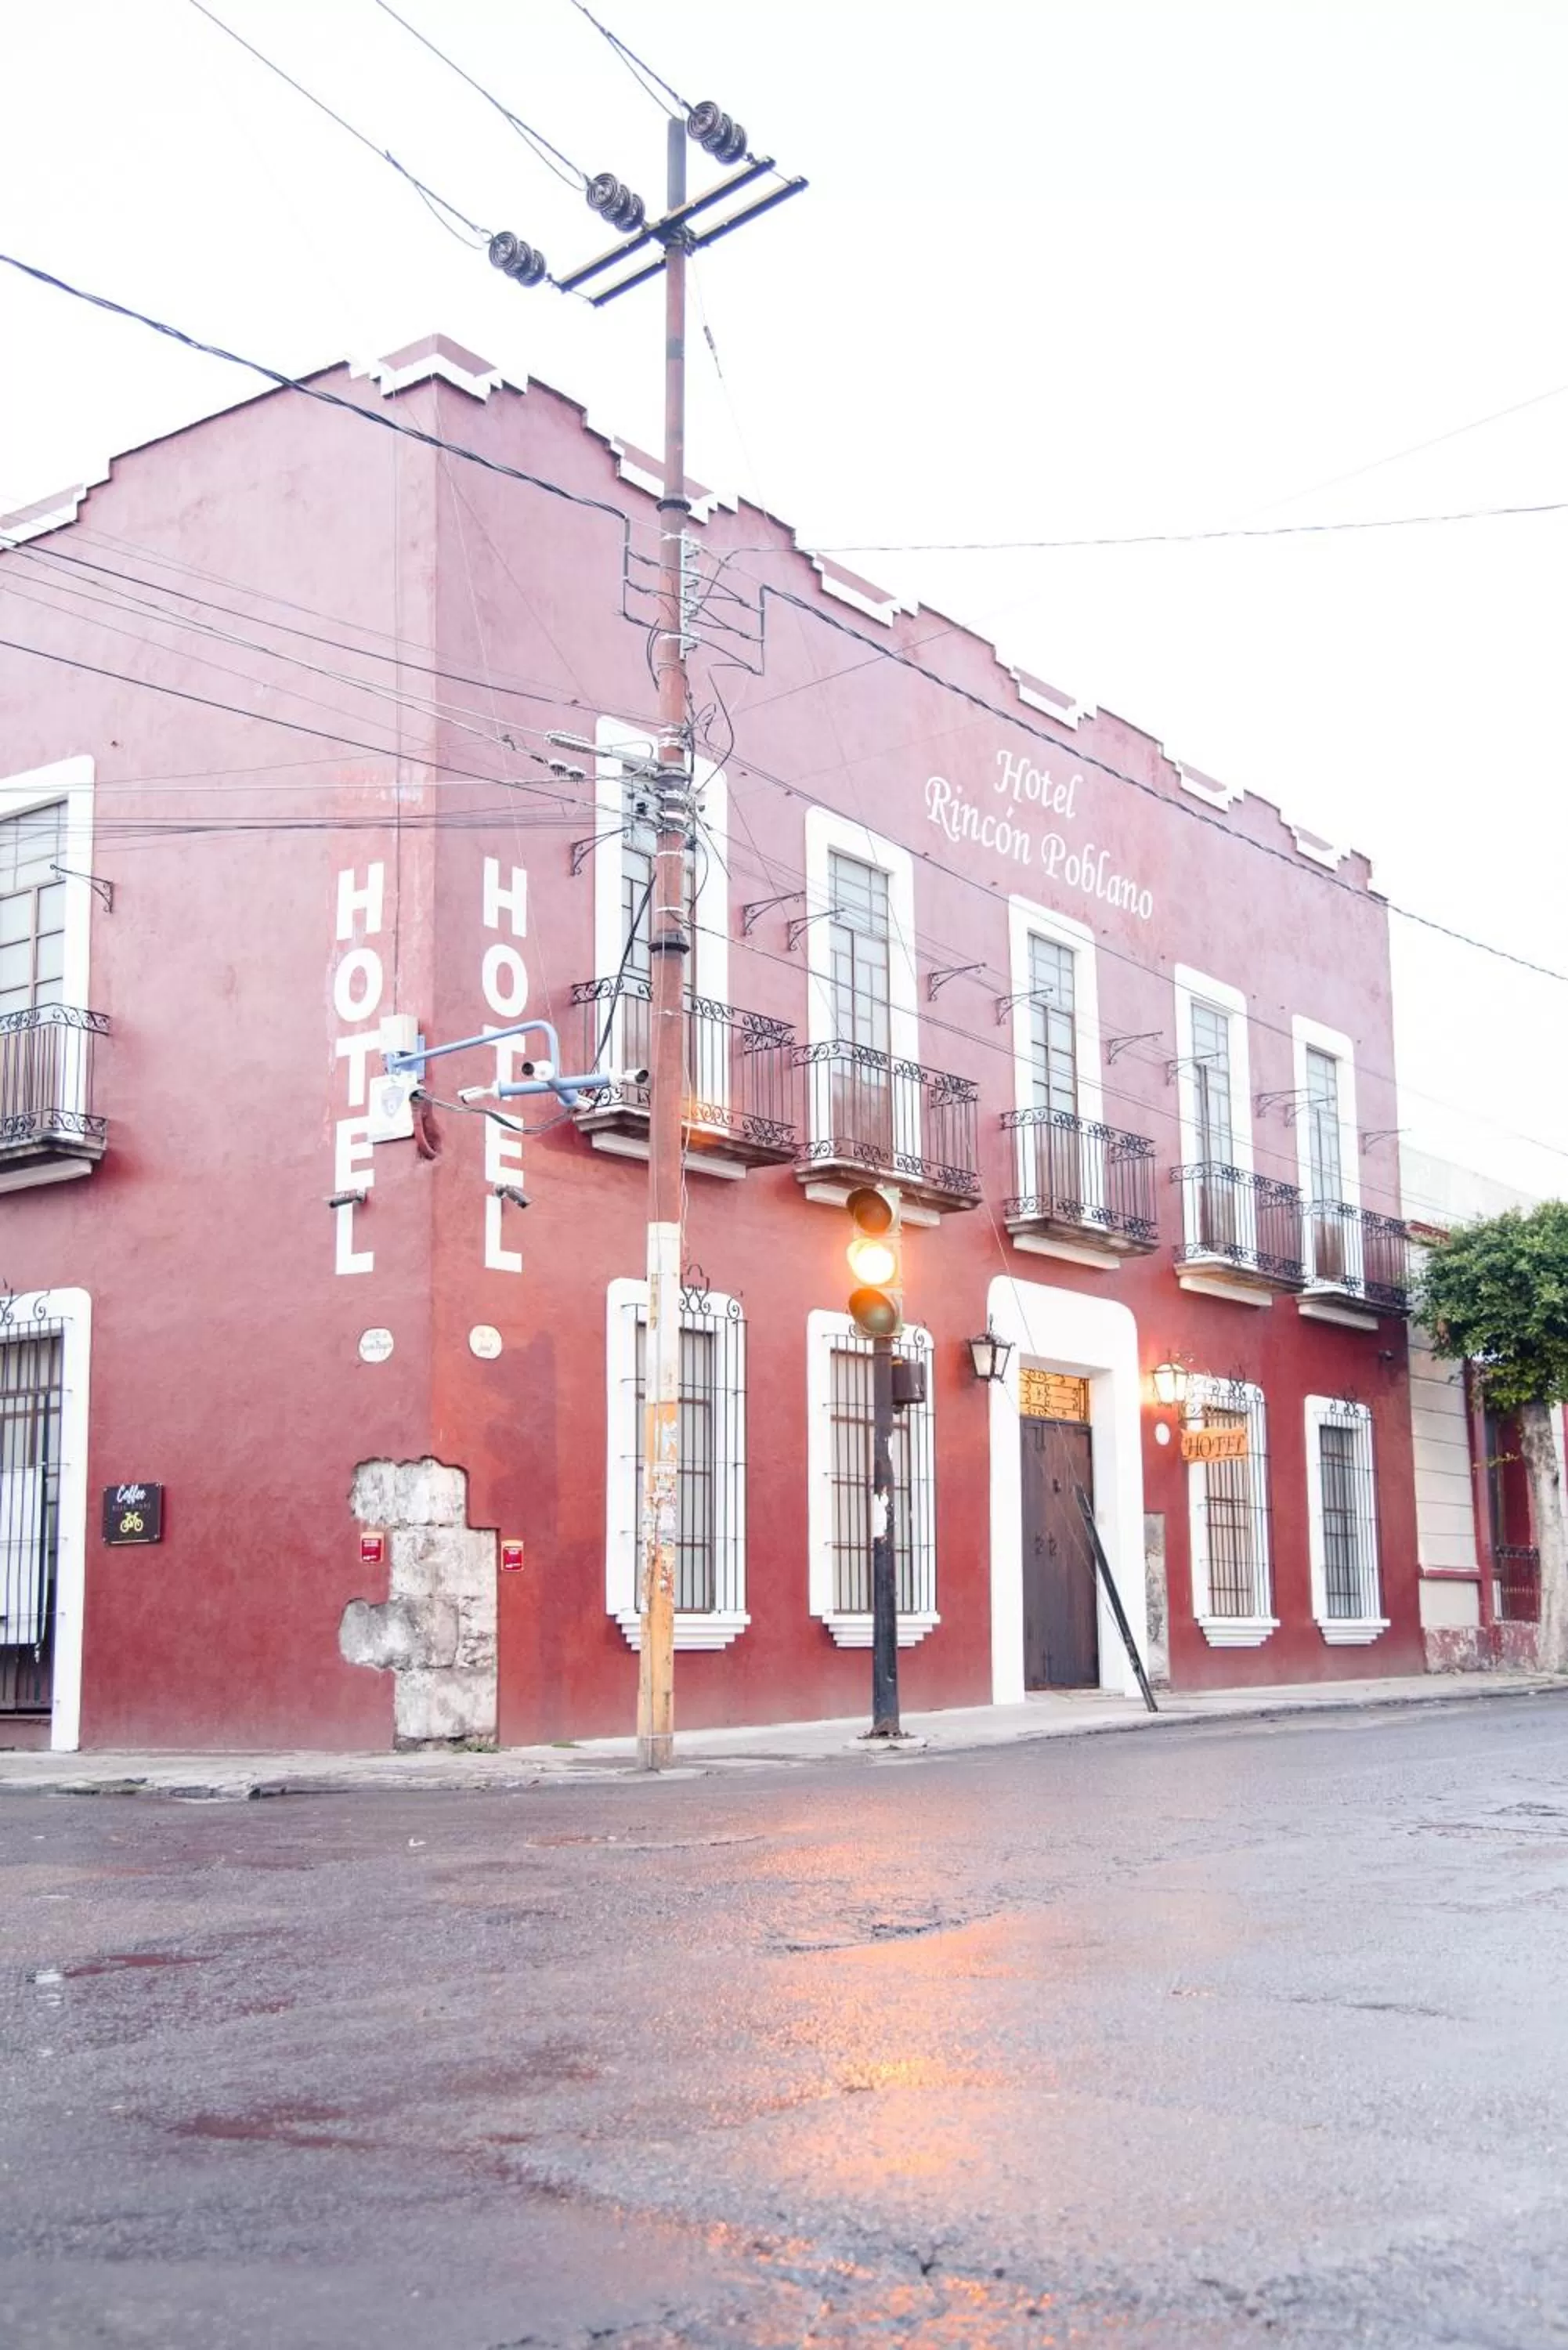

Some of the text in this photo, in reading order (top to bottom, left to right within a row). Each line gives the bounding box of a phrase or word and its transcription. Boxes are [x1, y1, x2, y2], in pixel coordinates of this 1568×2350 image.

[995, 750, 1083, 819] Hotel
[925, 776, 1153, 919] Rincón Poblano
[334, 861, 385, 1275] HOTEL
[482, 857, 528, 1273] HOTEL
[117, 1484, 146, 1504] Coffee
[1183, 1434, 1245, 1458] HOTEL
